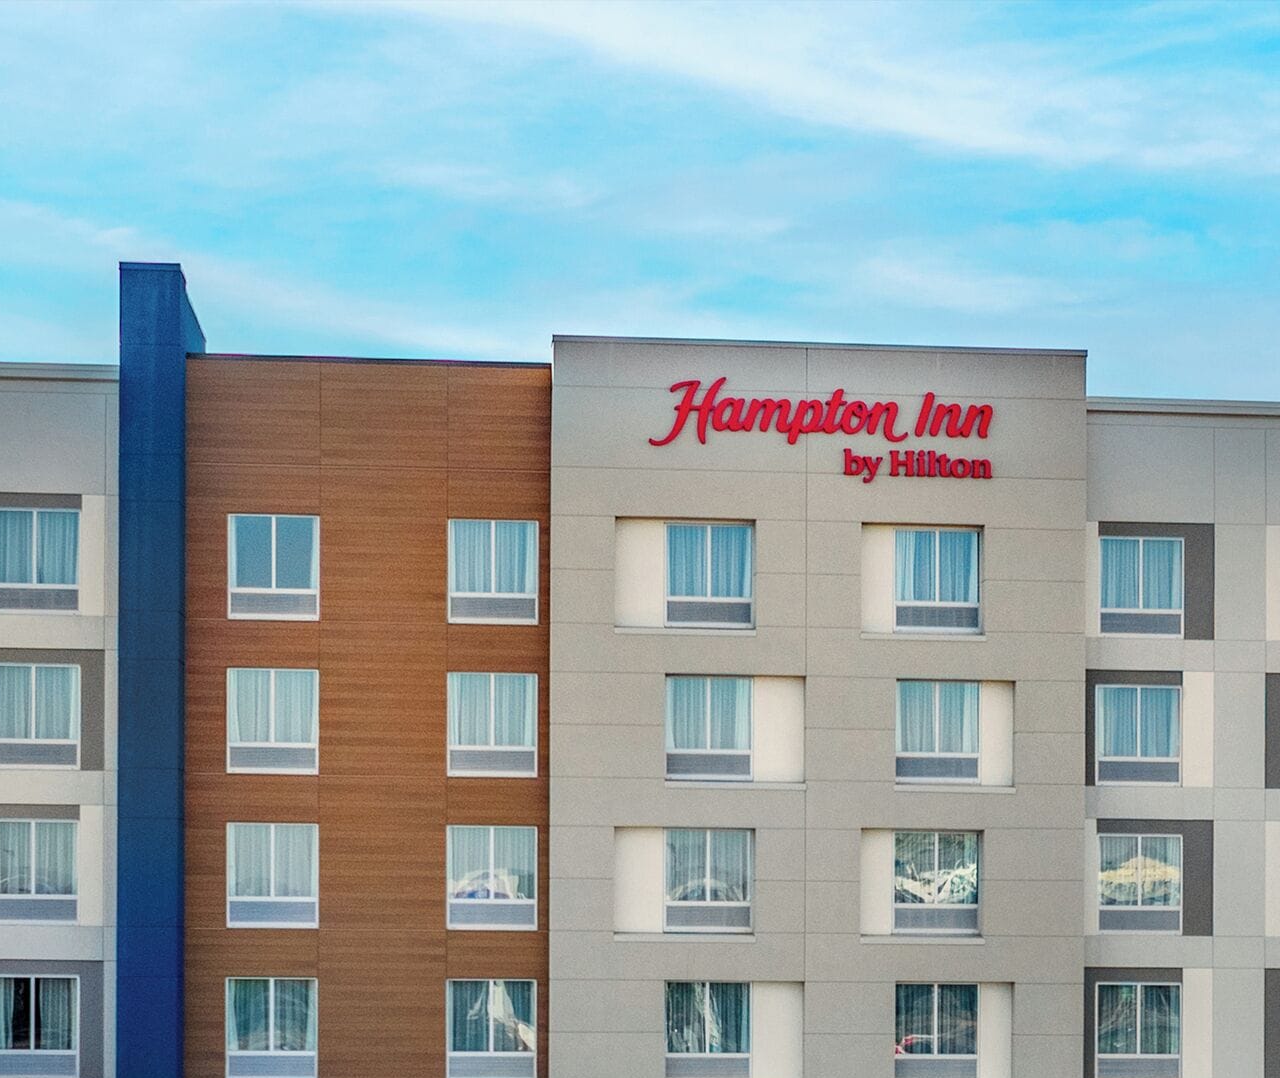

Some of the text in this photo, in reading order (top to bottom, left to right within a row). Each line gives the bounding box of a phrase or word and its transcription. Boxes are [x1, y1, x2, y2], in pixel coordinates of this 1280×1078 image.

[648, 376, 994, 447] Hampton Inn
[843, 448, 993, 484] by Hilton
